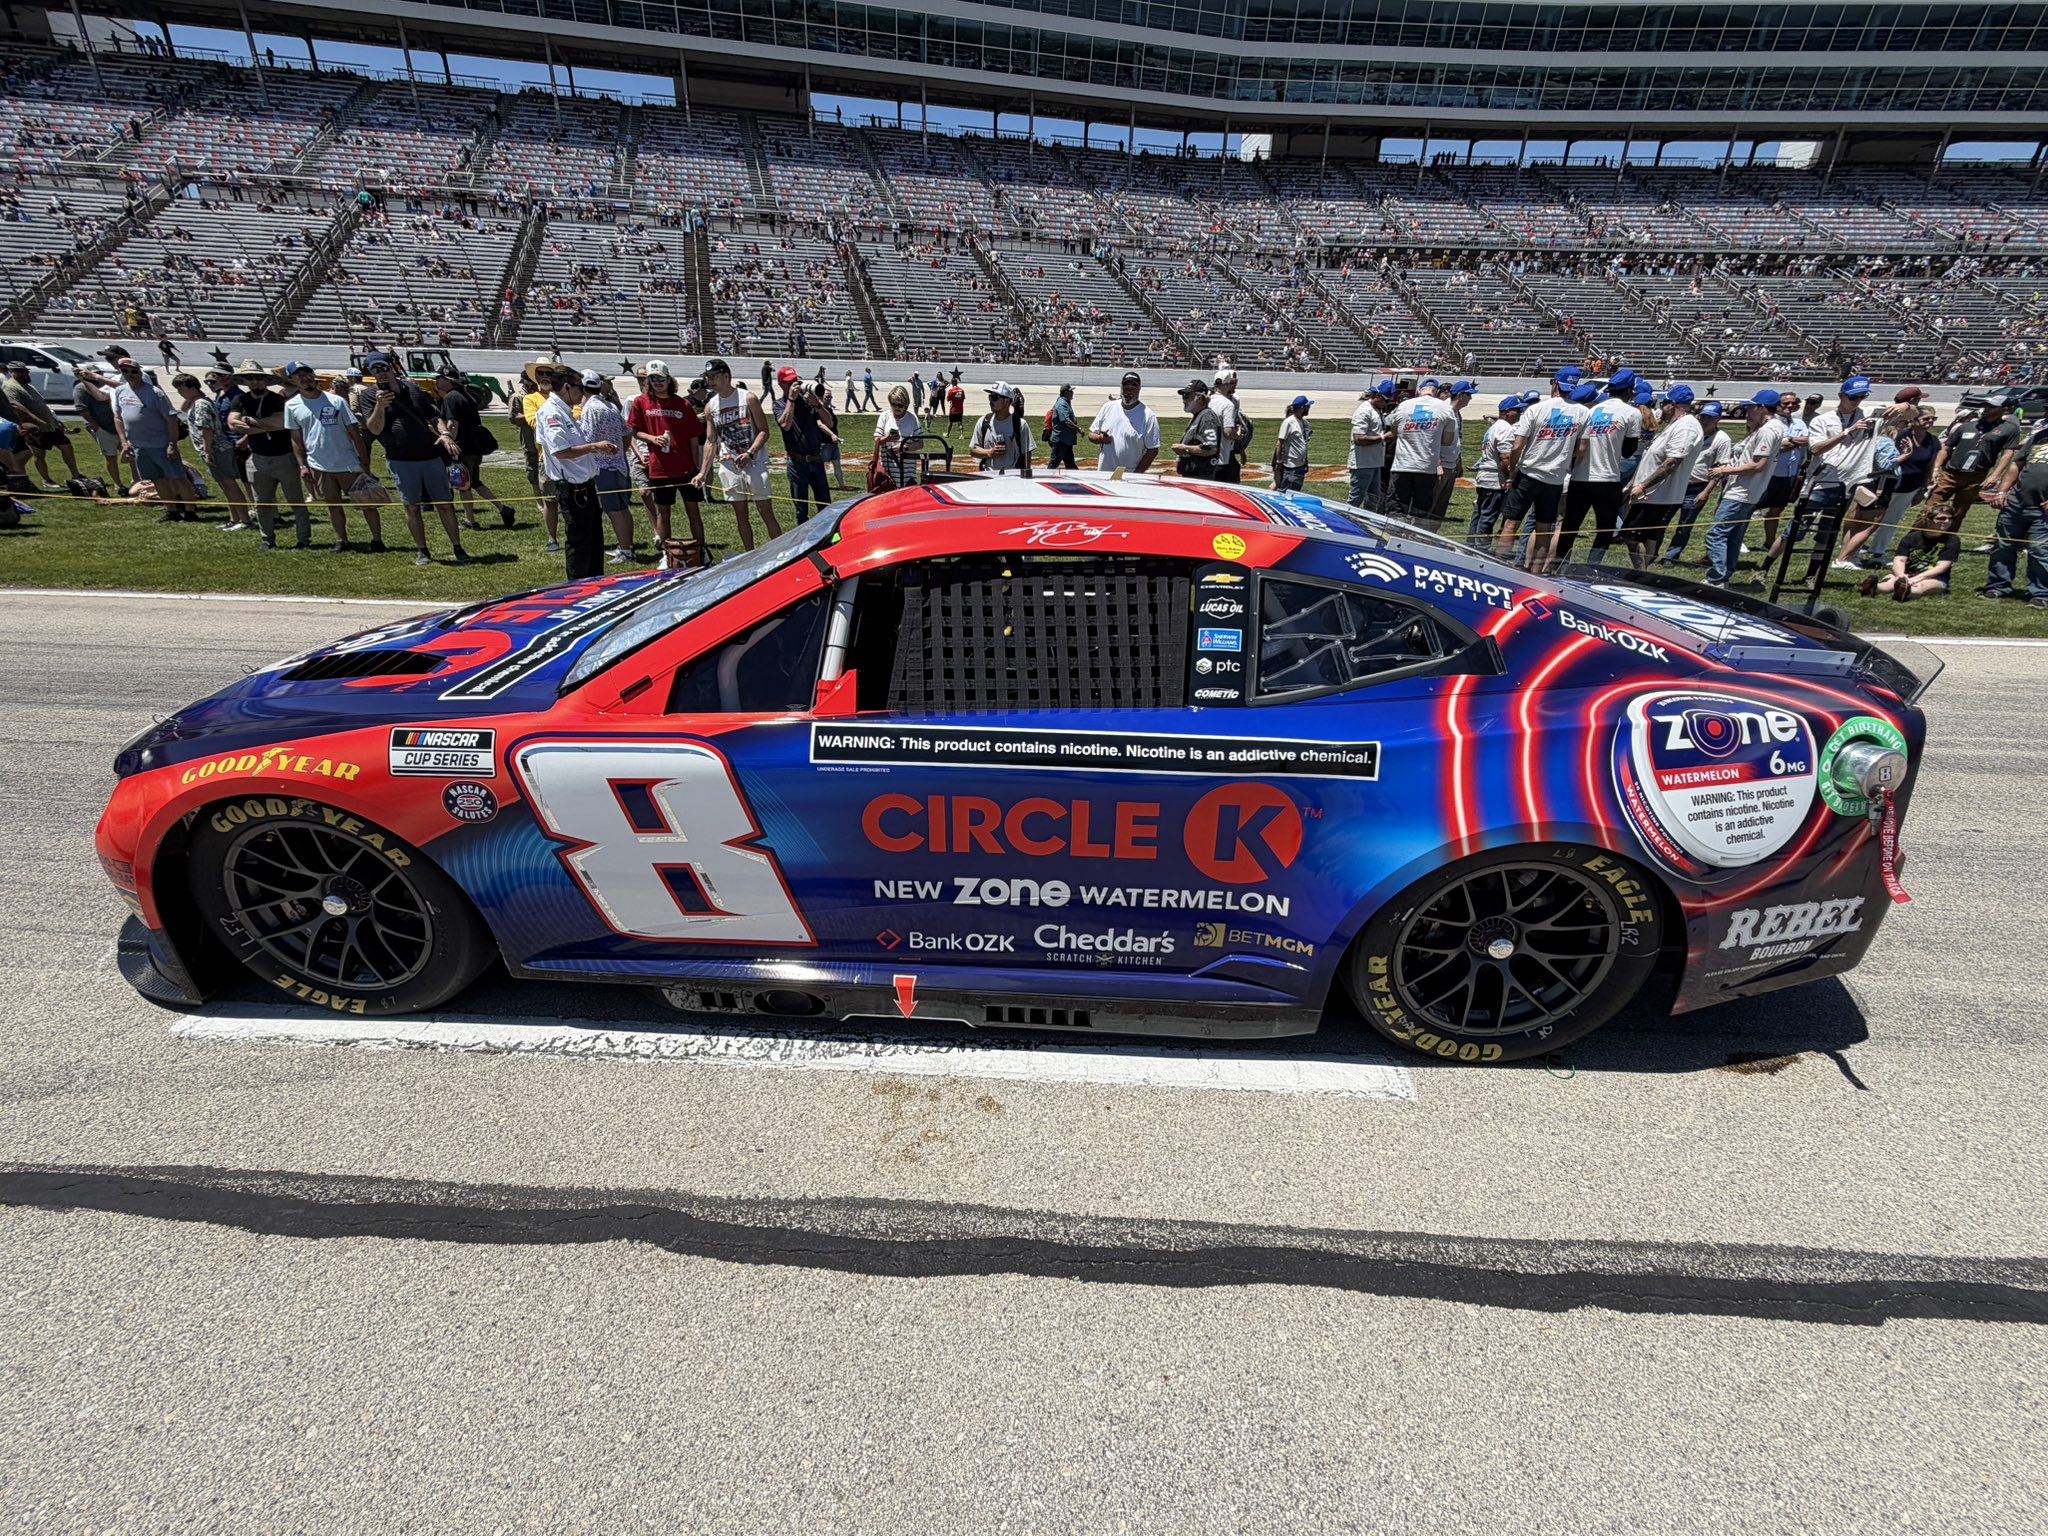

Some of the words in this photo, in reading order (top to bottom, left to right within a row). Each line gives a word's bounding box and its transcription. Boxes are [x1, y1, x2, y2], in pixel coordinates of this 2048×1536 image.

[1413, 564, 1513, 602] PATRIOT
[1414, 579, 1513, 611] MOBILE
[1199, 602, 1229, 613] LUCAS
[1229, 604, 1244, 614] OIL
[1216, 658, 1241, 674] ptc
[1194, 688, 1240, 699] COMETIC
[422, 732, 480, 748] NASCAR
[818, 735, 896, 750] WARNING:
[900, 736, 931, 750] This
[934, 739, 991, 753] product
[994, 741, 1056, 755] contains
[1060, 742, 1122, 758] nicotine.
[1126, 744, 1186, 760] Nicotine
[1190, 746, 1203, 760] is
[1206, 750, 1225, 761] an
[1228, 748, 1297, 762] addictive
[1300, 749, 1373, 764] chemical.
[403, 752, 434, 767] CUP
[434, 752, 480, 767] SERIES
[1661, 768, 1740, 787] WATERMELON
[449, 785, 487, 798] NASCAR
[1691, 791, 1736, 807] WARNING:
[1735, 789, 1756, 802] This
[1755, 784, 1789, 801] product
[451, 806, 493, 819] SALUTES
[1687, 805, 1725, 822] contains
[1725, 802, 1762, 818] nicotine.
[1762, 797, 1796, 813] Nicotine
[862, 793, 1161, 861] CIRCLE
[1626, 783, 1681, 862] WATERMELON
[1714, 821, 1724, 833] is
[1724, 820, 1736, 832] an
[1737, 814, 1775, 830] addictive
[507, 736, 818, 946] 8
[1725, 828, 1766, 846] chemical.
[1881, 835, 1895, 862] BEFORE
[1581, 854, 1654, 924] EAGLE
[1883, 873, 1905, 897] TRACK
[873, 879, 944, 900] NEW
[952, 877, 1072, 908] zone
[1079, 884, 1291, 918] WATERMELON
[1718, 896, 1866, 950] REBEL
[1033, 923, 1176, 954] Cheddar's
[1227, 928, 1315, 957] BETMGM
[1750, 939, 1814, 960] BOURBON
[1046, 952, 1093, 963] SCRATCH
[1117, 955, 1163, 966] KITCHEN
[272, 972, 367, 1015] EAGLE
